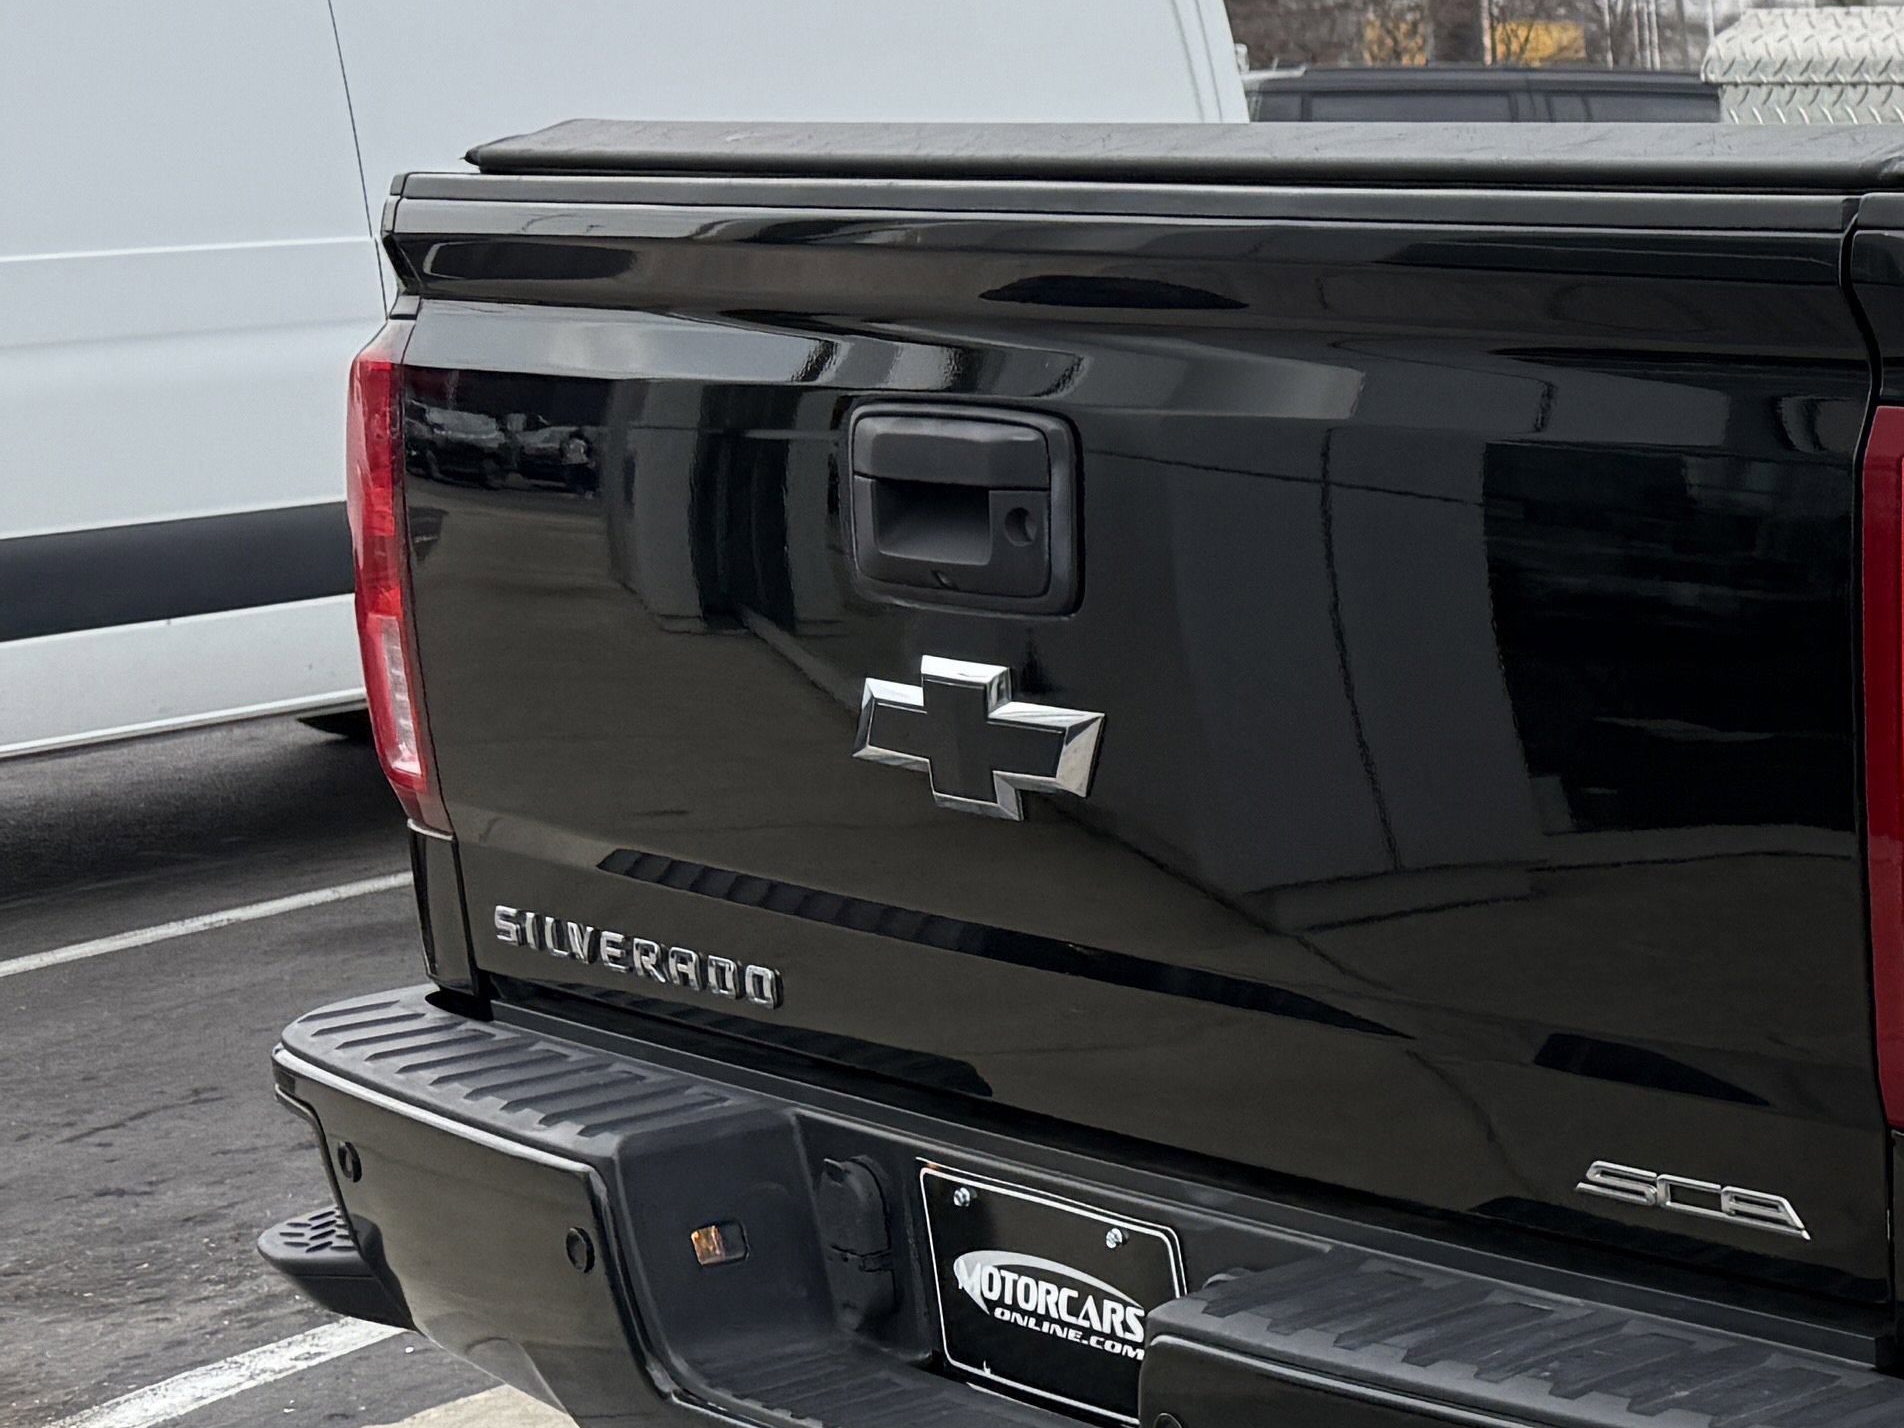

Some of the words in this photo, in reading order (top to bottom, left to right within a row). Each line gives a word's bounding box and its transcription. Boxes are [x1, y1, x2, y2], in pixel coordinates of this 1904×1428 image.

[494, 904, 784, 1010] SILVERADO
[957, 1258, 1145, 1343] MOTORCARS
[993, 1306, 1145, 1360] ONLINE.COM
